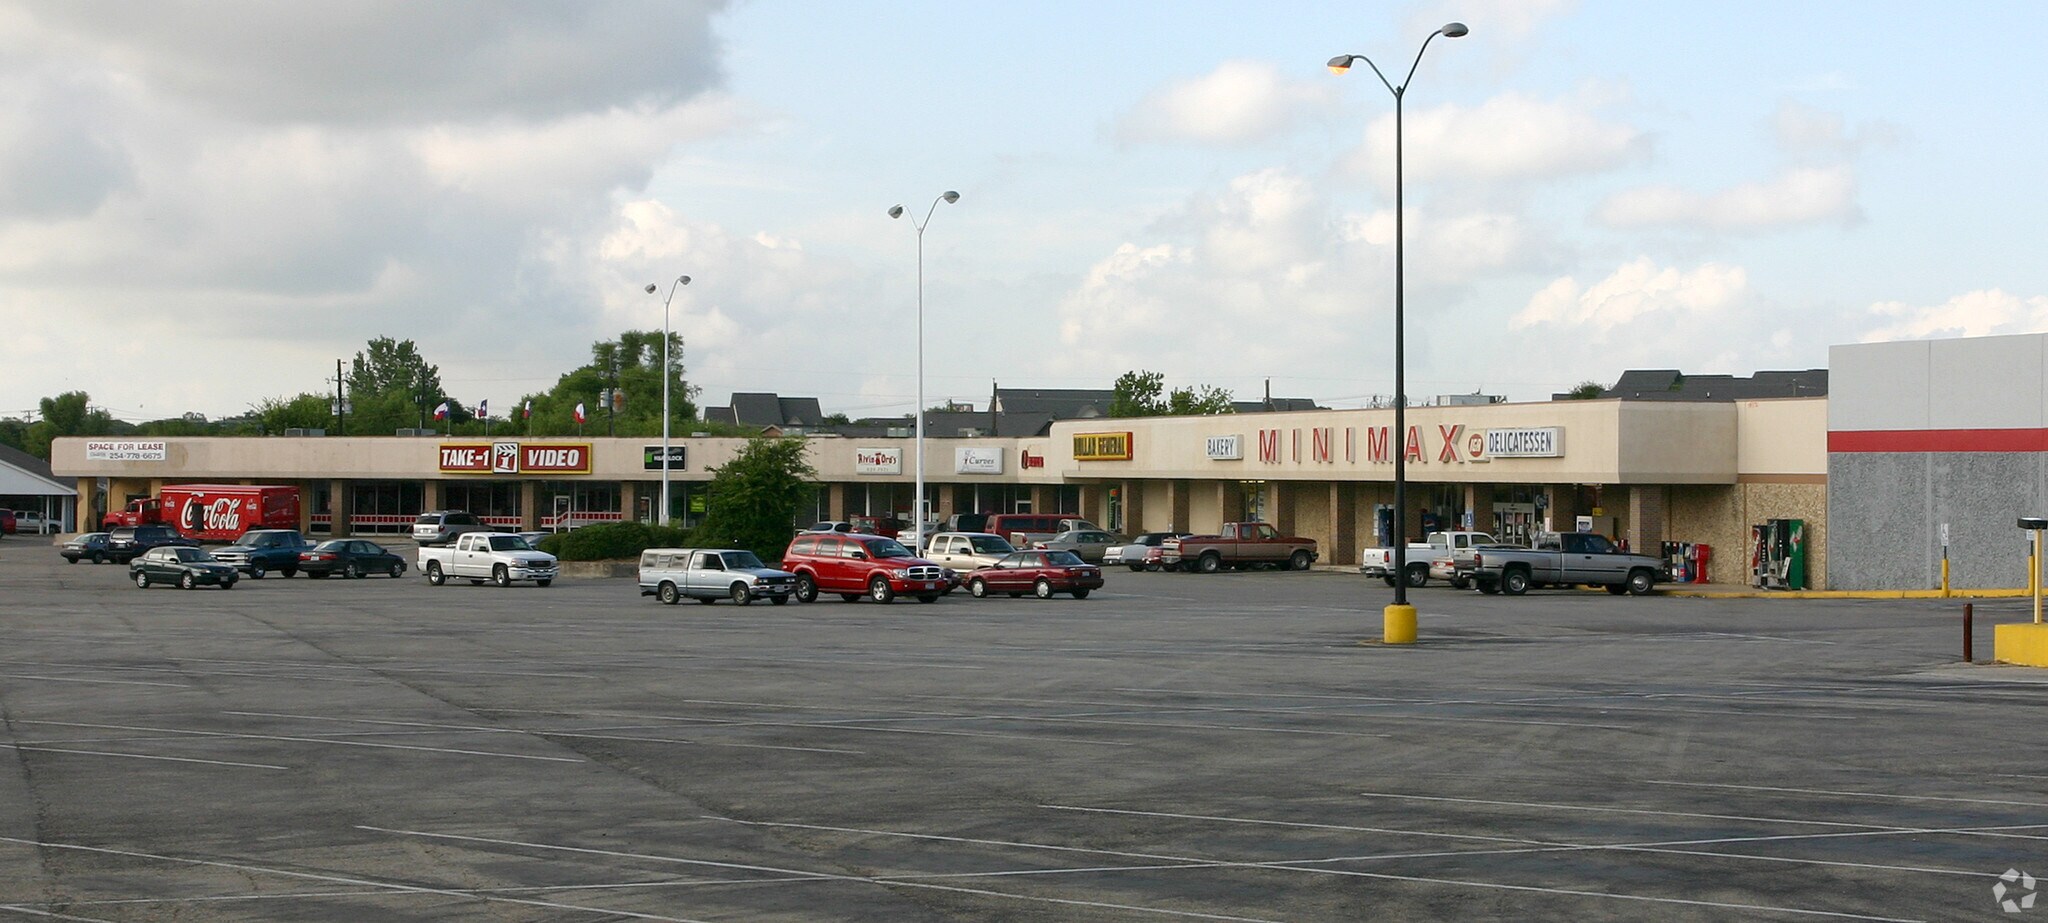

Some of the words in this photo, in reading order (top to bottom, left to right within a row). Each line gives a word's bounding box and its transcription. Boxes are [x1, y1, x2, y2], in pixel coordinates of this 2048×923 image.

[88, 443, 114, 451] SPACE
[117, 443, 134, 451] FOR
[137, 443, 164, 451] LEASE
[1073, 437, 1096, 456] DOLLAR
[1098, 436, 1125, 456] GENERAL
[1208, 439, 1234, 456] BAKERY
[1259, 425, 1462, 462] MINIMAX
[1489, 431, 1552, 452] DELICATESSEN
[441, 449, 490, 466] TAKE-1
[528, 449, 580, 466] VIDEO
[969, 456, 995, 465] Curves
